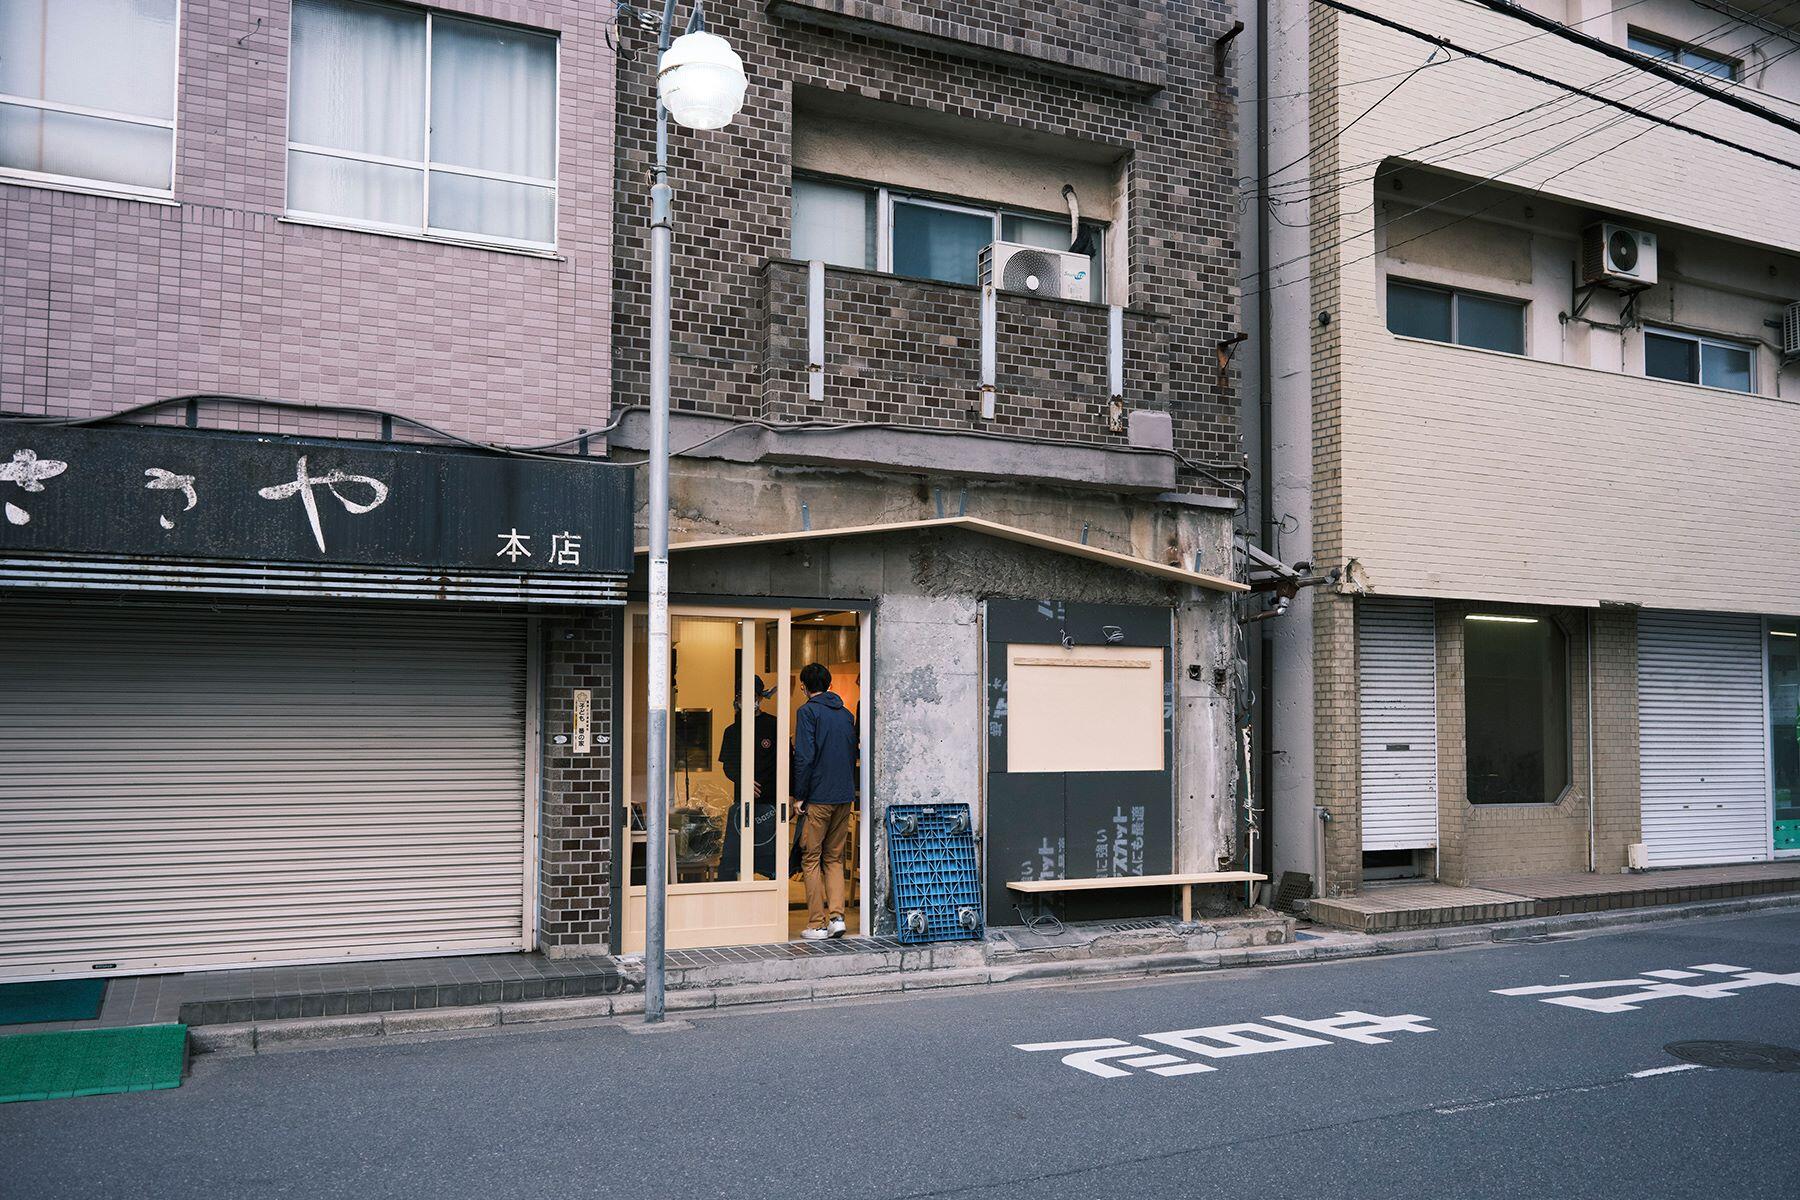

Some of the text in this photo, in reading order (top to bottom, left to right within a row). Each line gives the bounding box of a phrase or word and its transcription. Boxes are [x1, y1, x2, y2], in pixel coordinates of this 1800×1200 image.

[496, 527, 582, 566] 本店
[1096, 829, 1109, 878] に強い
